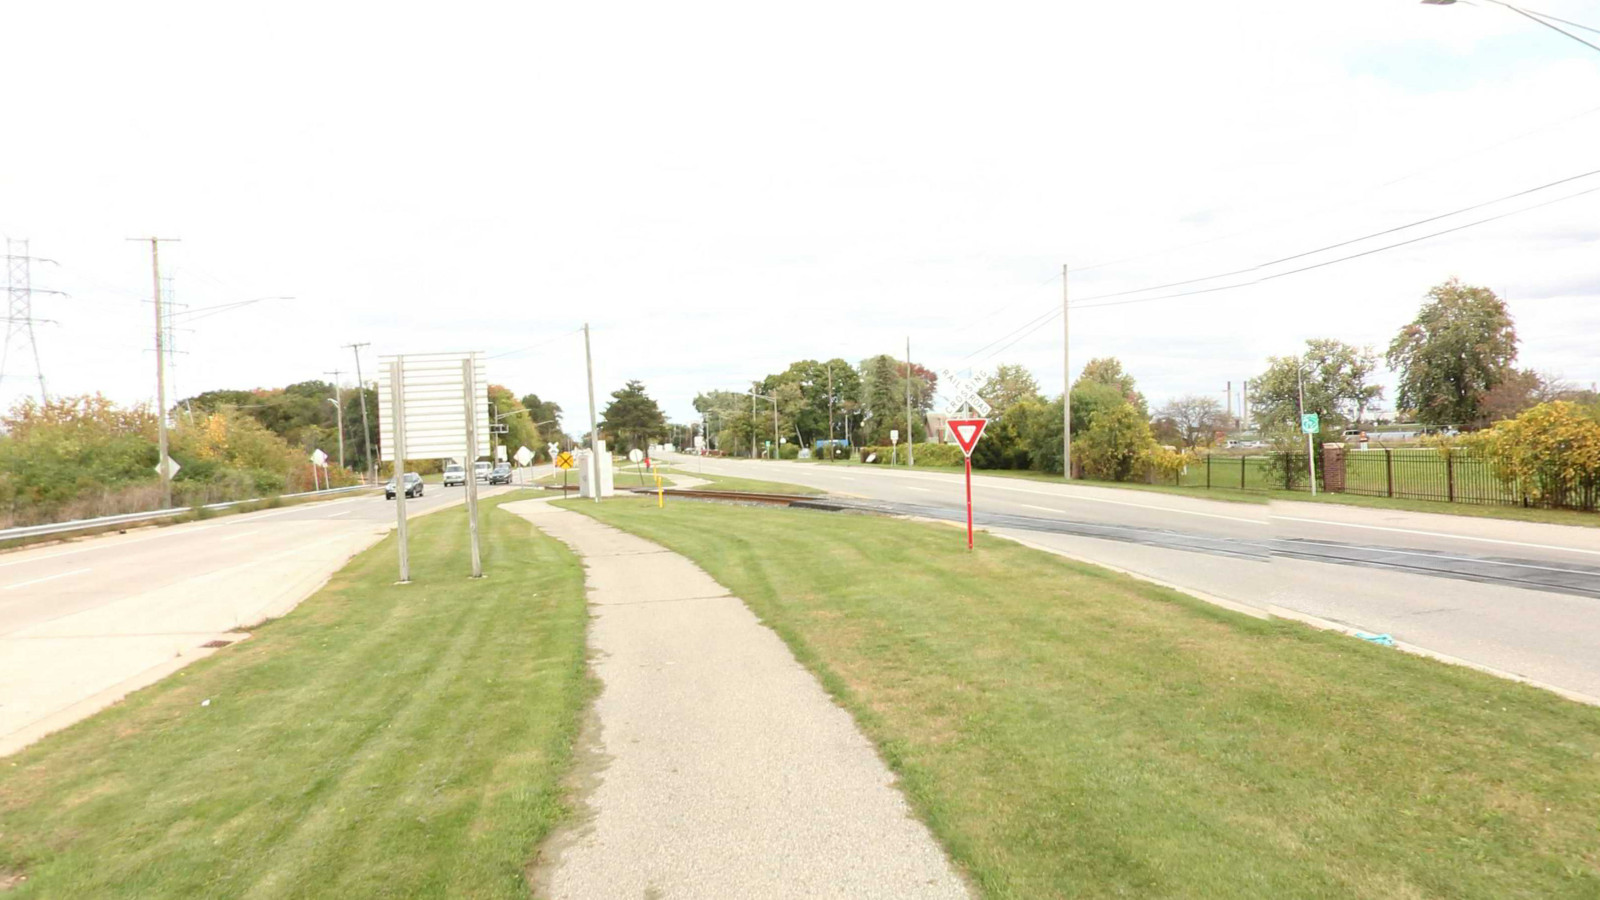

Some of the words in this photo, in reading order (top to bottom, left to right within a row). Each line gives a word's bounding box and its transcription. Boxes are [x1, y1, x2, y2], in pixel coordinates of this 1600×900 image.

[942, 369, 961, 389] RAIL
[968, 394, 989, 416] ROAD
[945, 369, 987, 414] CROSSING
